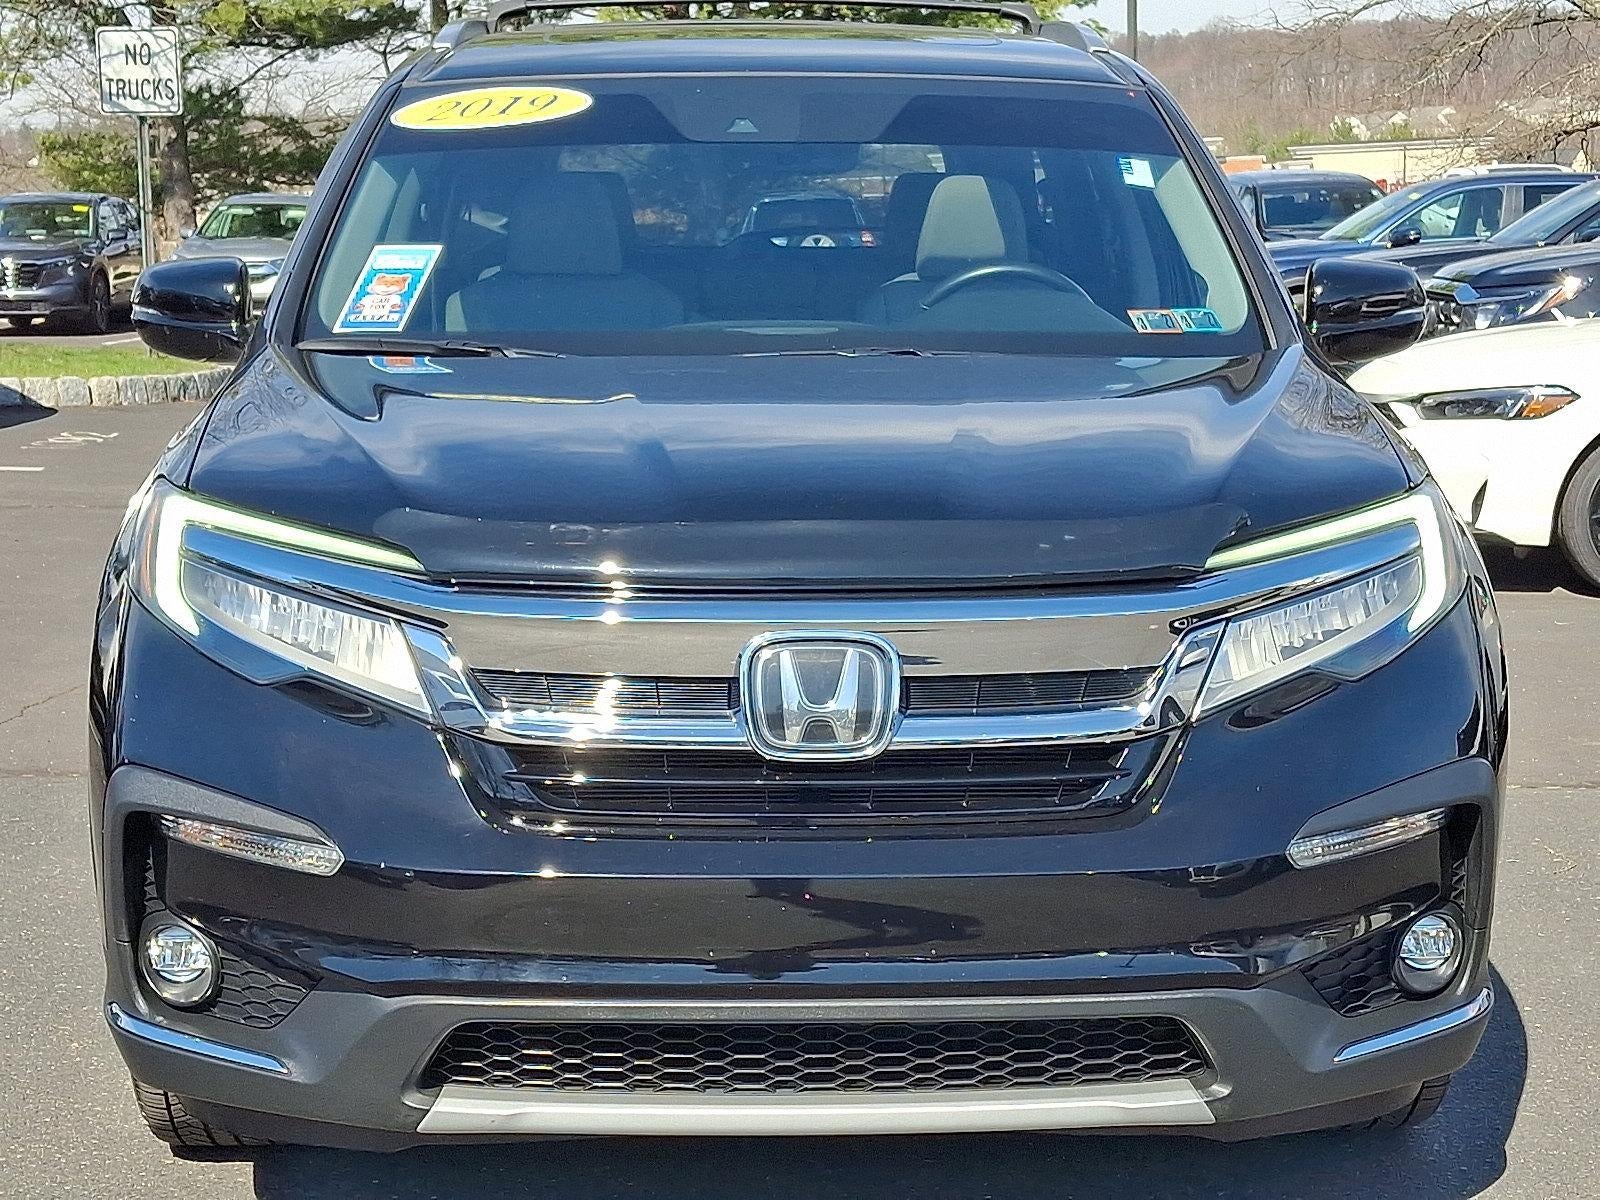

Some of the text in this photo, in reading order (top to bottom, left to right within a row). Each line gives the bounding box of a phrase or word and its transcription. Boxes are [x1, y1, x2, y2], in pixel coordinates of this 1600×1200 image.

[124, 43, 152, 65] NO
[105, 78, 175, 101] TRUCKS
[424, 93, 559, 122] 2019
